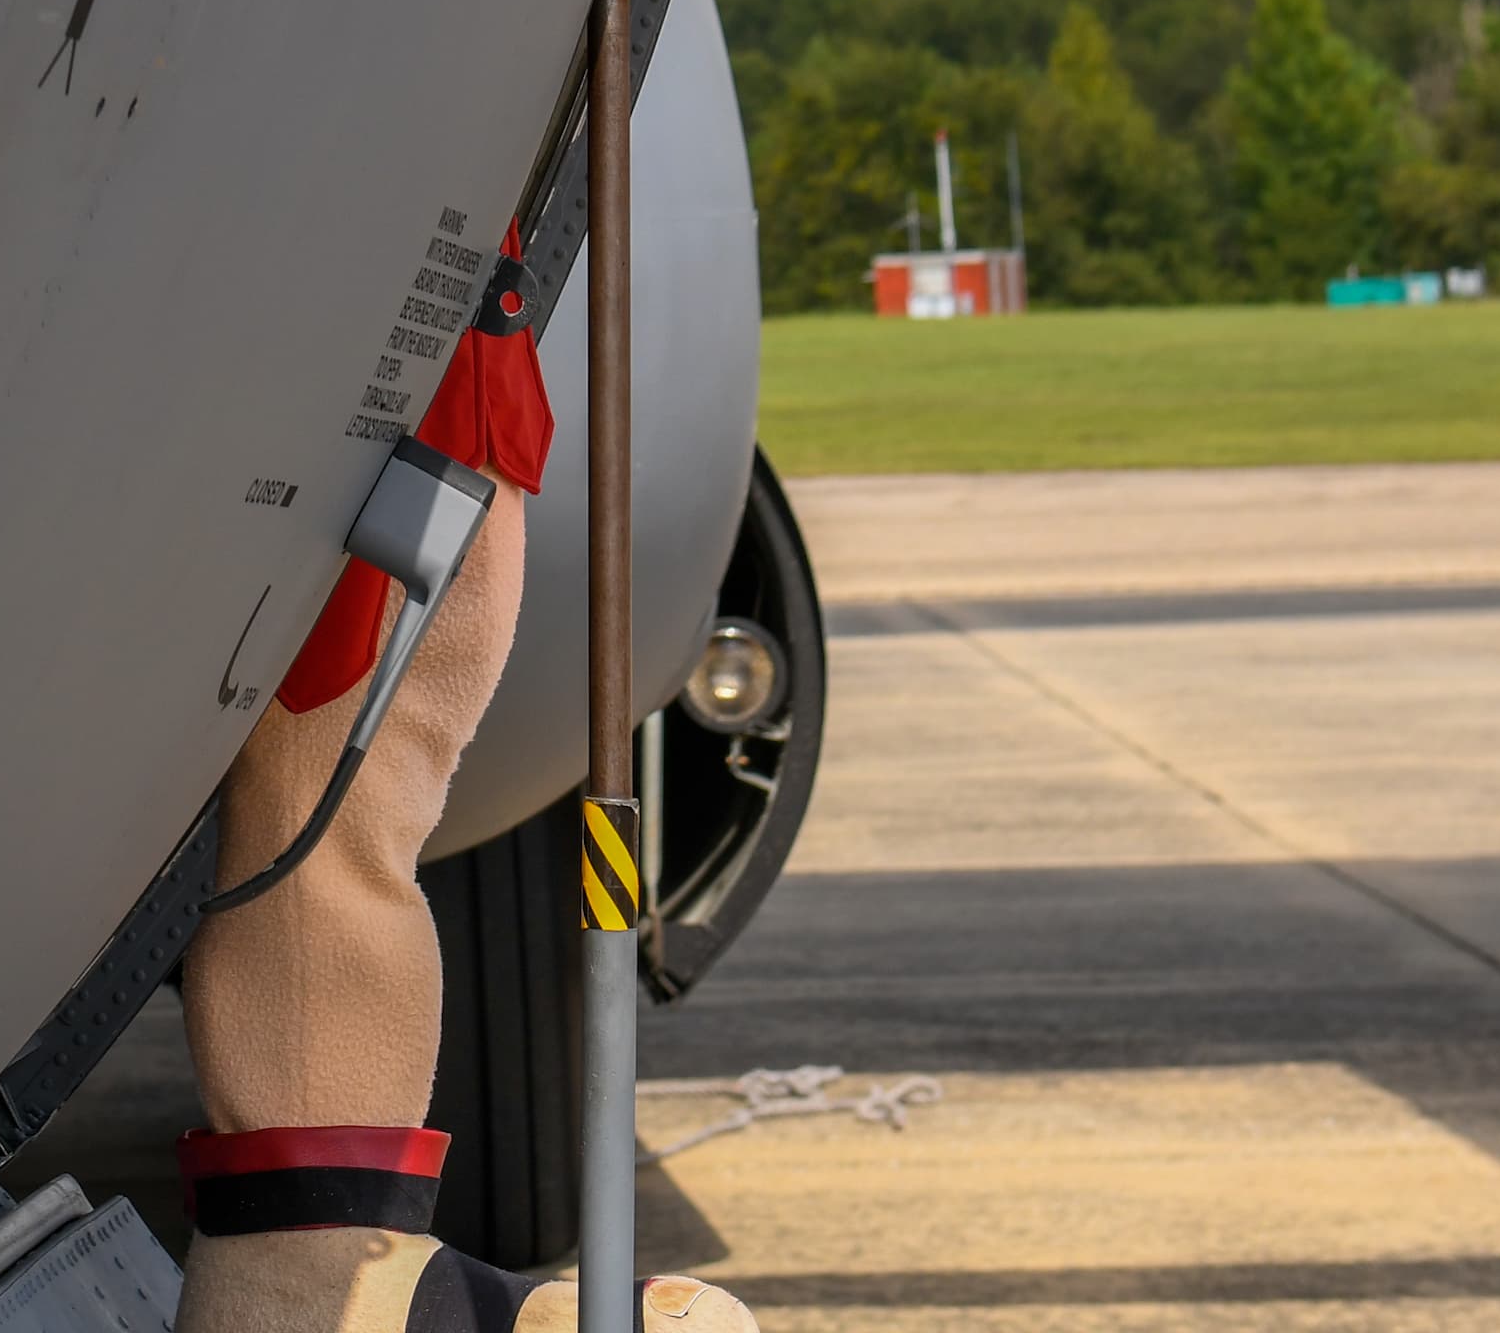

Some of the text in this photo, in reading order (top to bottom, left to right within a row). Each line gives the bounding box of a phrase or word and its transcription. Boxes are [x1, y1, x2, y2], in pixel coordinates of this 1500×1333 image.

[437, 206, 468, 236] WARNING
[387, 326, 407, 350] FROM
[245, 478, 286, 505] CLOSED
[236, 686, 260, 710] OPEN
